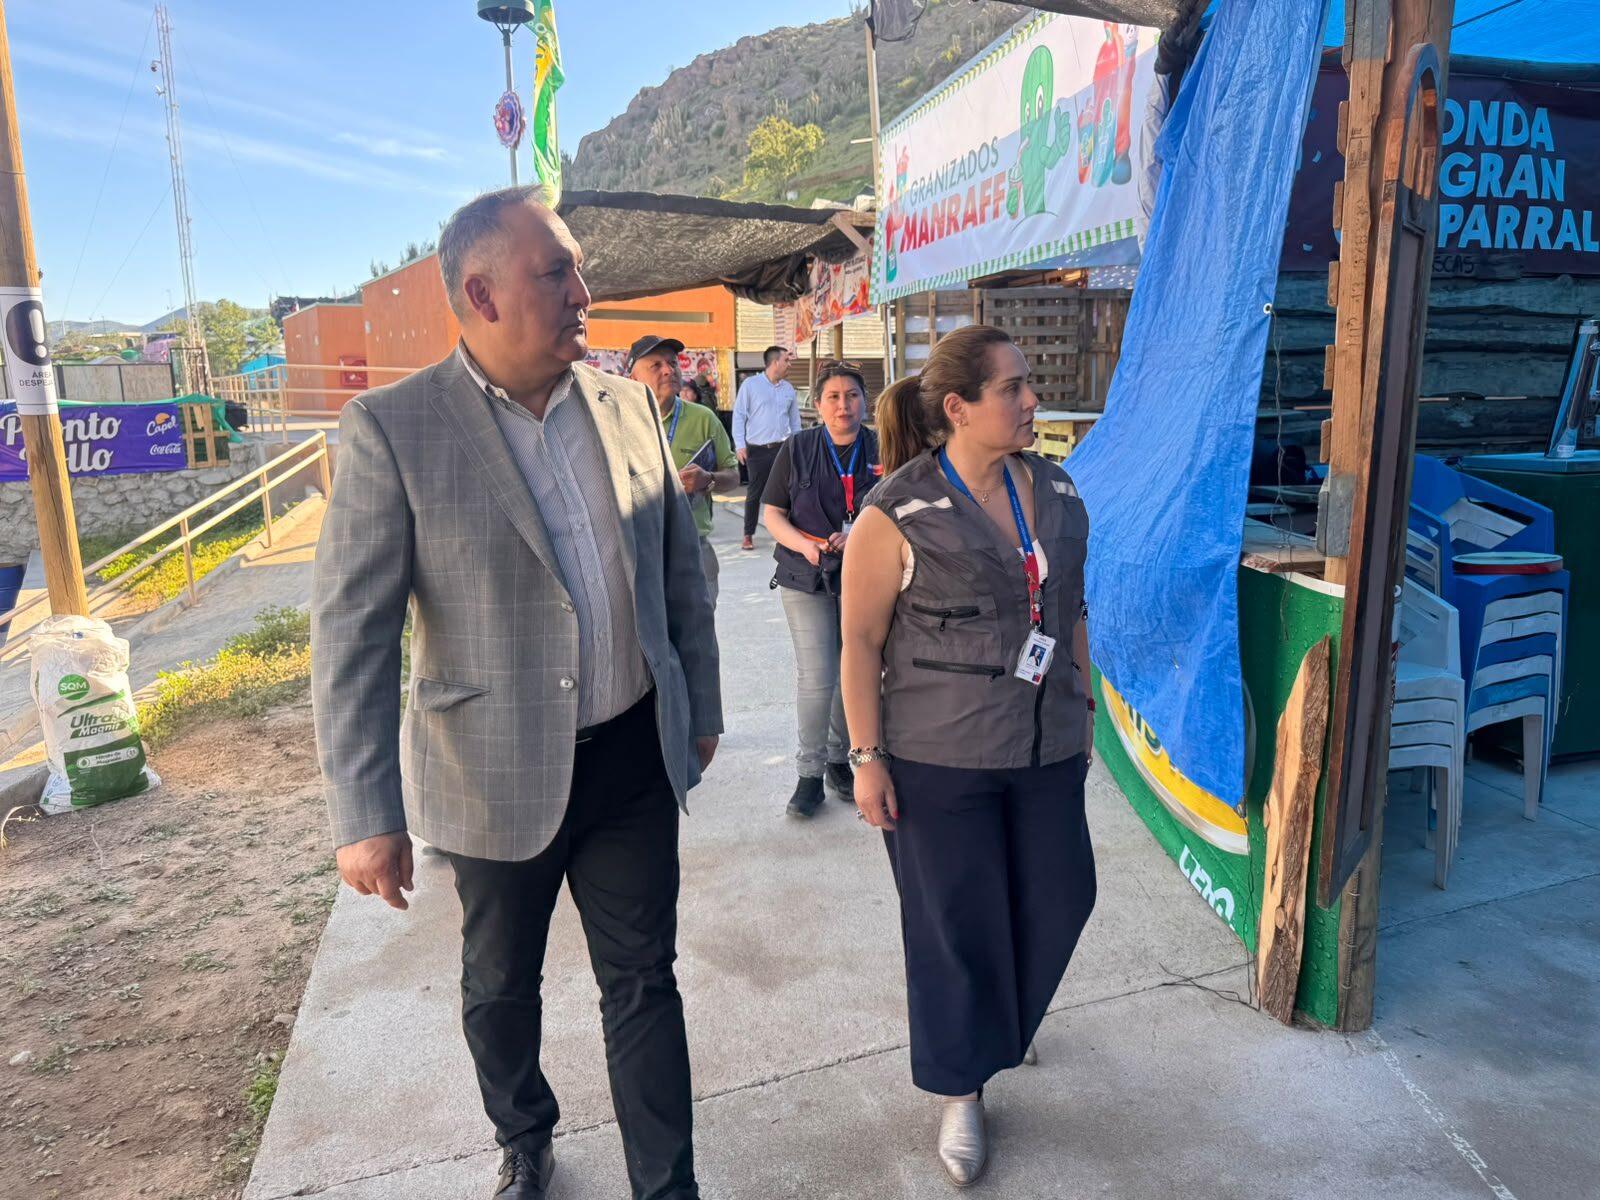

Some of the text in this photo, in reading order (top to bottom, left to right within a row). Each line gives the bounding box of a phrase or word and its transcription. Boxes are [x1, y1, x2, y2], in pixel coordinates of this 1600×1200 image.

[1441, 98, 1555, 152] ONDA
[910, 136, 999, 207] GRANIZADOS
[1439, 152, 1566, 202] GRAN
[1437, 204, 1599, 253] PARRAL
[0, 412, 122, 446] Pnto
[146, 415, 177, 437] Capel
[60, 682, 87, 690] SQM
